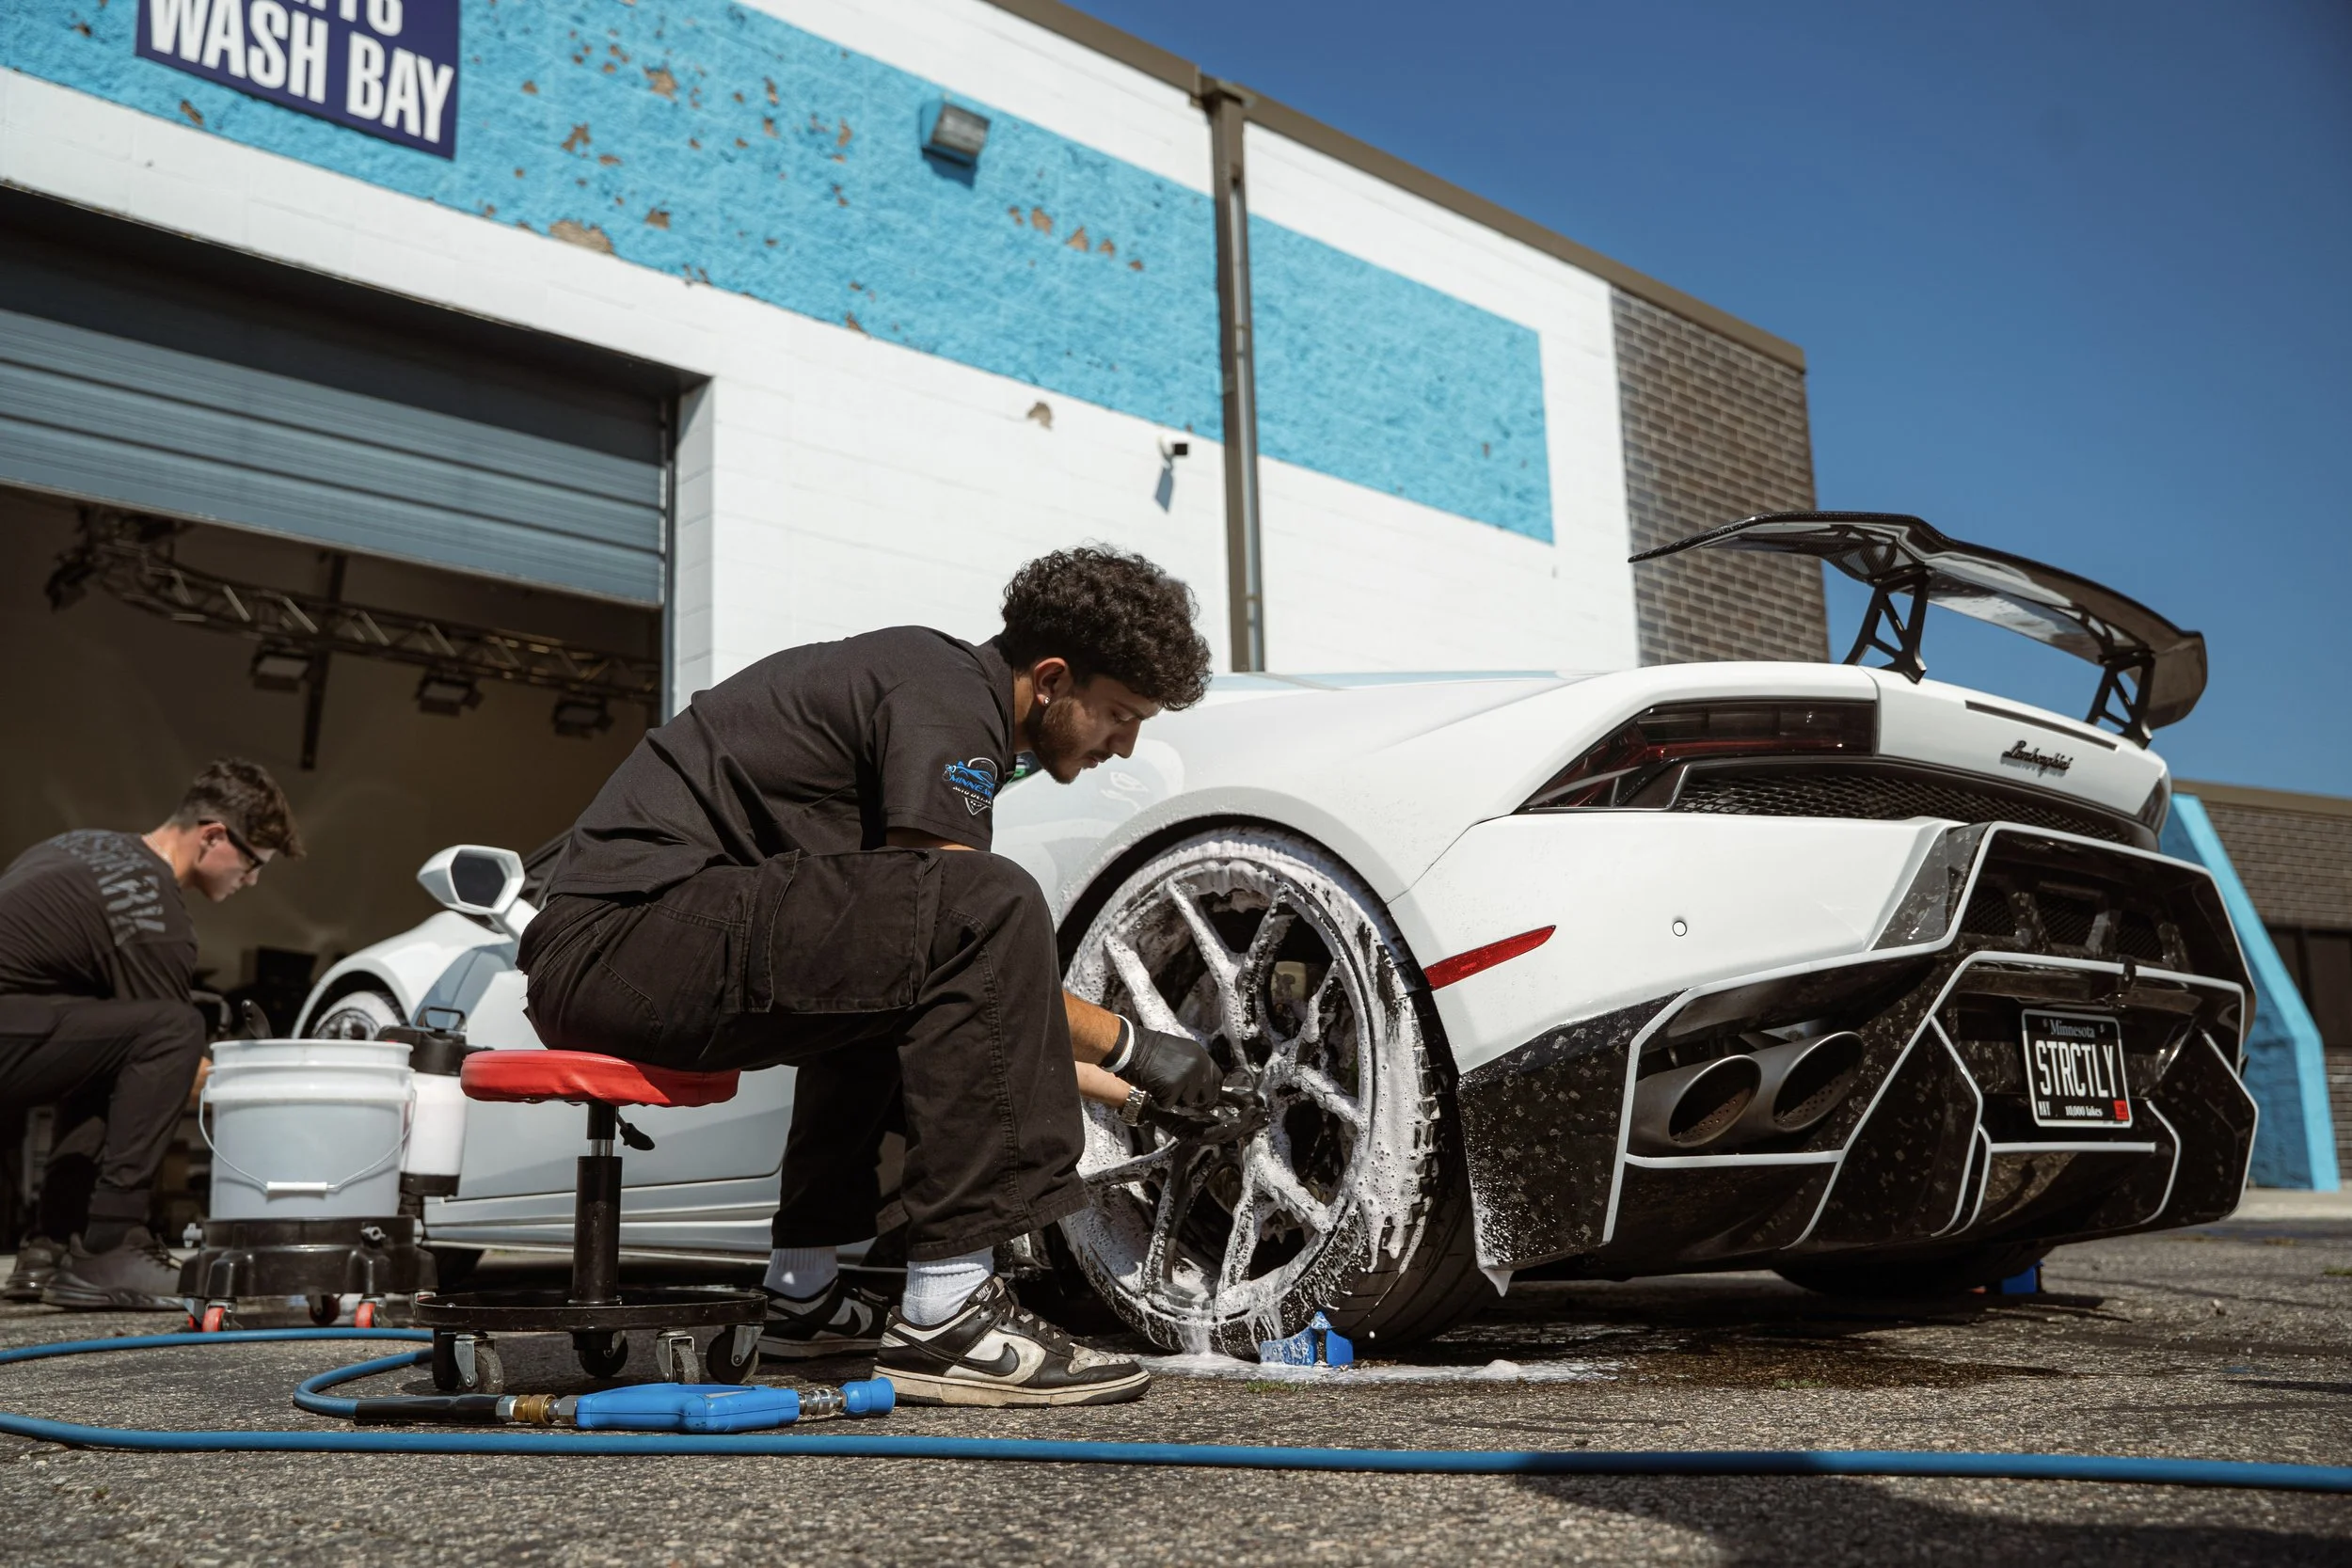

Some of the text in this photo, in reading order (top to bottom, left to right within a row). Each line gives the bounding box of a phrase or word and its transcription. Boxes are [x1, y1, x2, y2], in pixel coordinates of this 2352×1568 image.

[148, 0, 454, 144] WASH BAY
[2049, 1019, 2096, 1038] Minnesota
[2035, 1039, 2117, 1099] STRCTLY
[2037, 1101, 2051, 1117] MAY
[2065, 1105, 2087, 1117] 10,000
[2085, 1105, 2104, 1117] lakes
